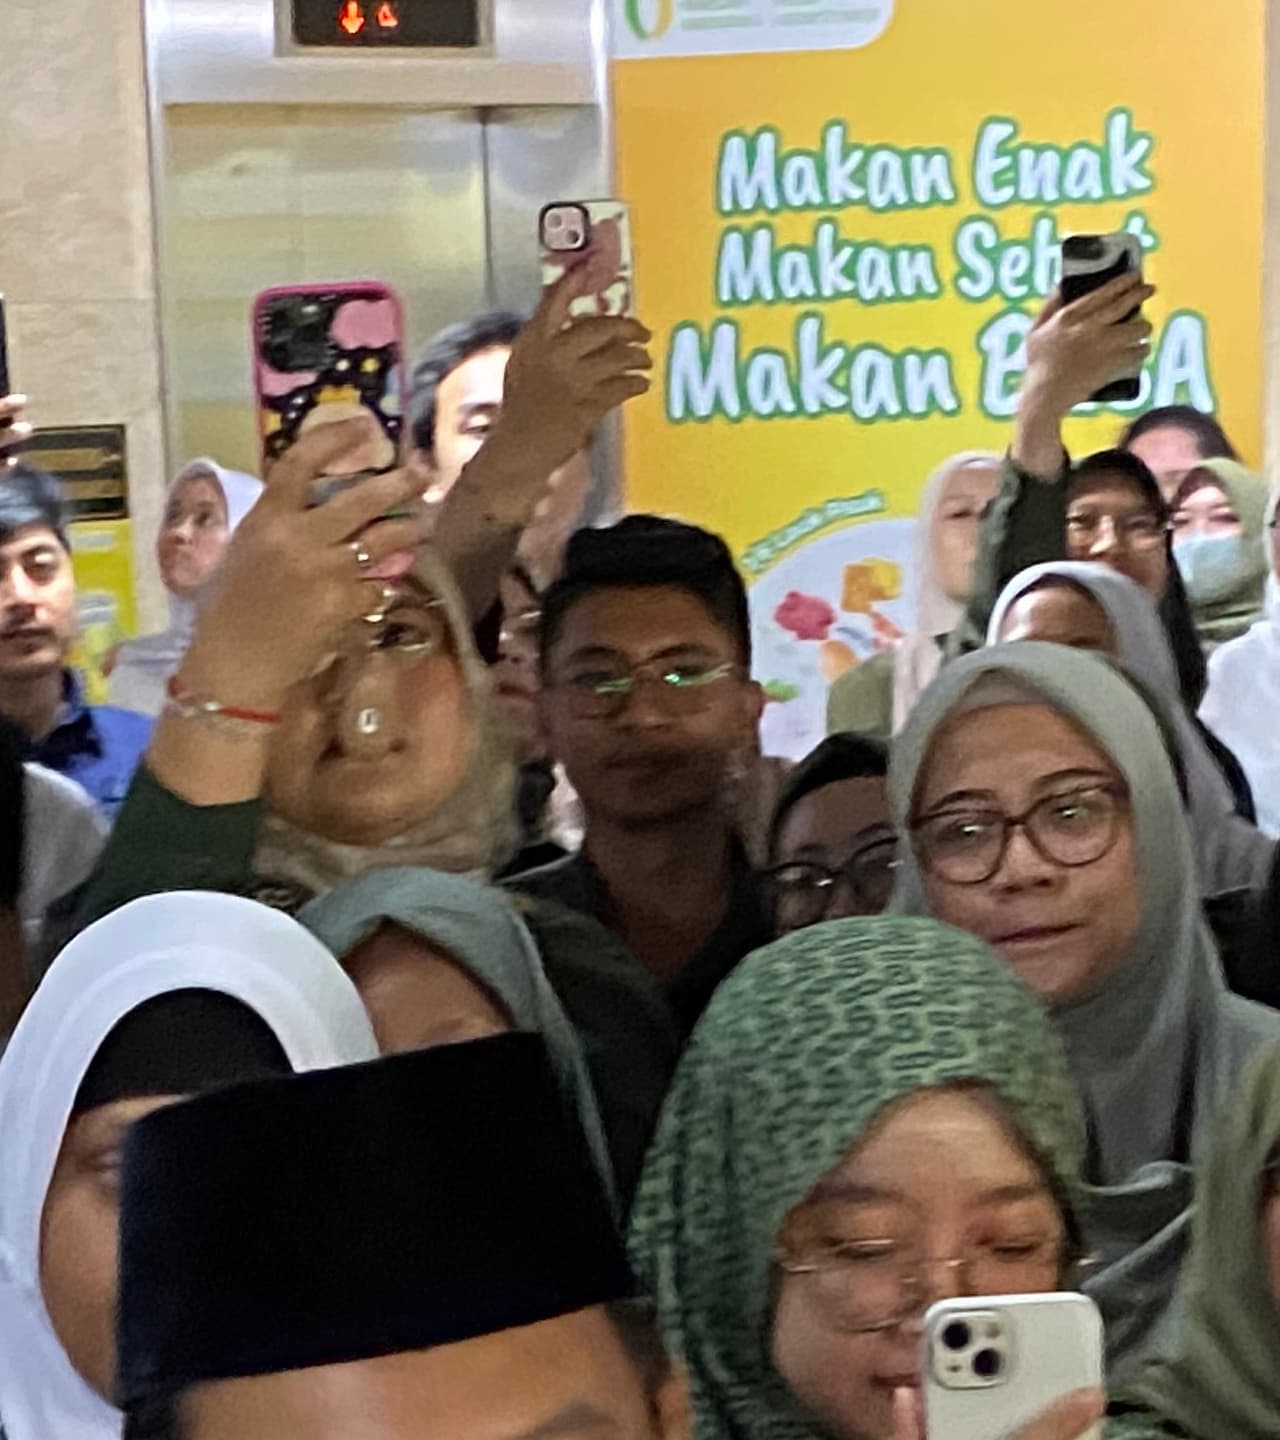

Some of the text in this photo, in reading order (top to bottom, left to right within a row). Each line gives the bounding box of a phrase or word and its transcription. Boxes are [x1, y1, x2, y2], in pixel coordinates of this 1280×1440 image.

[718, 109, 1154, 213] Makan Enak
[718, 212, 1157, 302] Makan Seh
[665, 309, 1216, 420] Makan BA
